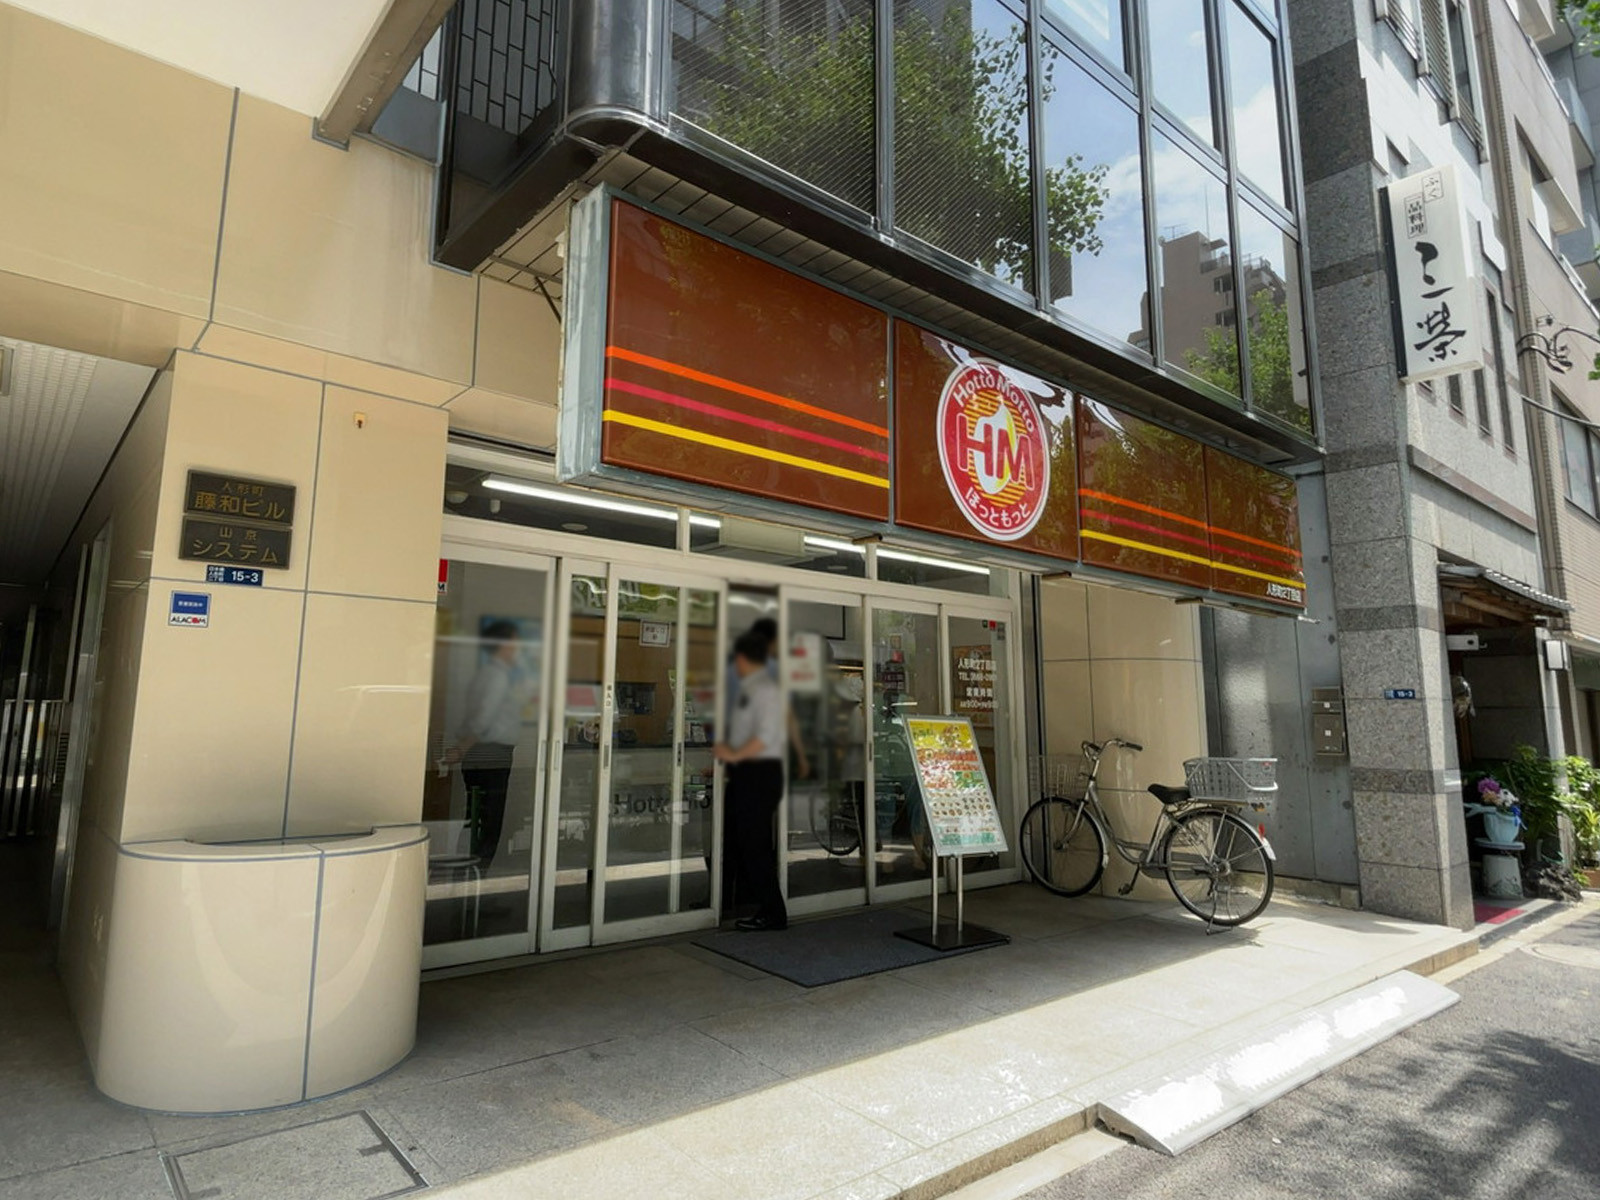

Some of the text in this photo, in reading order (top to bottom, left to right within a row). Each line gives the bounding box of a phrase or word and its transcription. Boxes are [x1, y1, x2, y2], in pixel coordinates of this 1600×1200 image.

[953, 373, 1036, 433] Hotto Motto
[956, 411, 1036, 492] HM
[223, 483, 264, 497] 人形町
[195, 491, 285, 519] 藤和ビル
[965, 486, 1031, 528] ほっともっと
[220, 528, 258, 542] 山京
[194, 540, 278, 564] システム
[231, 570, 259, 583] 15-3
